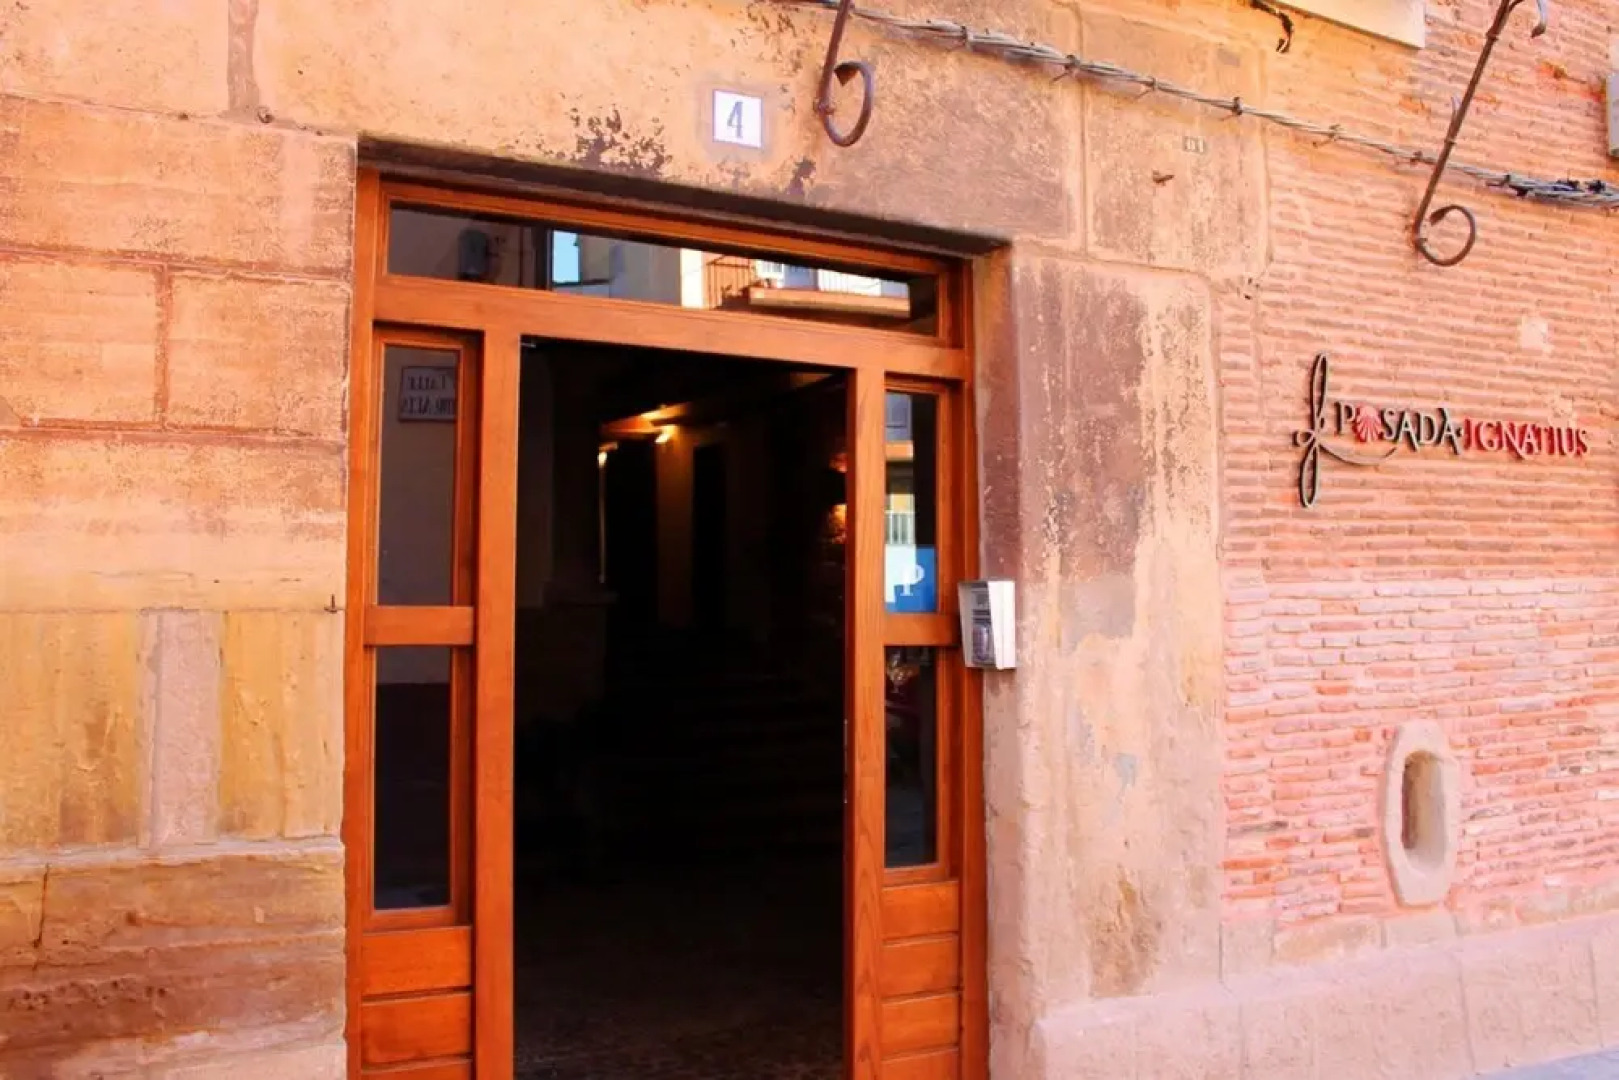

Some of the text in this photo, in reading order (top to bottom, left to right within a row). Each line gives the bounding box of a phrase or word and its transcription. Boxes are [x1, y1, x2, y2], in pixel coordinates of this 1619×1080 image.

[726, 100, 743, 138] 4
[1333, 400, 1588, 461] POSADA IGNATIUS
